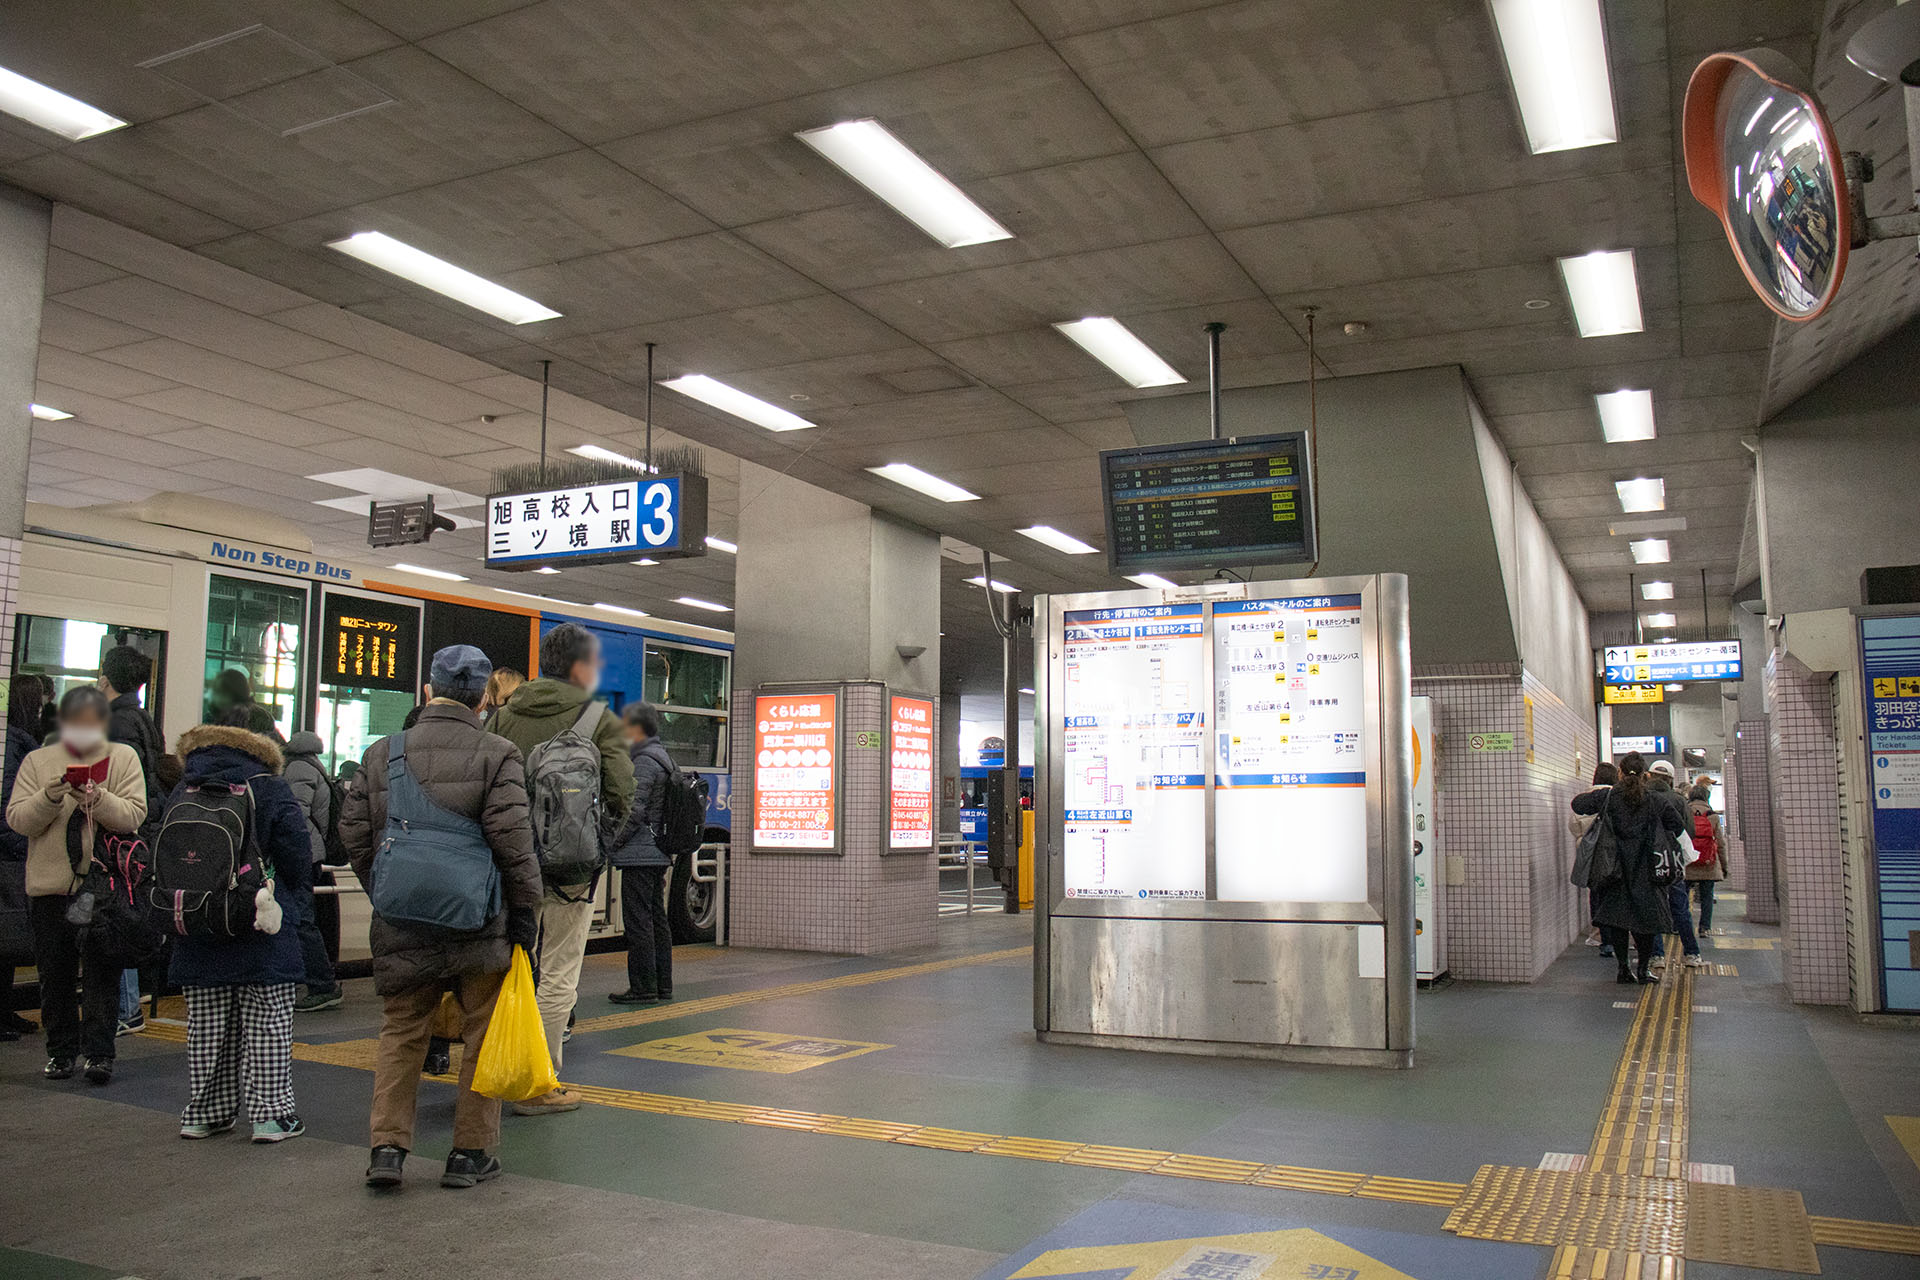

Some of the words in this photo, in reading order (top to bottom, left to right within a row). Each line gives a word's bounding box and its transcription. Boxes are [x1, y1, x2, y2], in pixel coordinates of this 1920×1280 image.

[494, 489, 630, 525] 旭高校入口
[642, 483, 674, 546] 3
[493, 519, 631, 554] 三ツ境駅
[211, 541, 256, 563] Non
[261, 551, 310, 574] Step
[314, 561, 352, 581] Bus
[357, 618, 398, 632] ニュータウン
[1277, 620, 1284, 629] 2
[1623, 650, 1629, 662] 1
[1278, 662, 1285, 671] 3
[1621, 666, 1633, 681] 0
[1691, 663, 1739, 674] 羽田空港
[1874, 701, 1920, 715] 羽田空
[1656, 737, 1665, 753] 1
[1153, 775, 1187, 785] お知らせ
[1272, 774, 1308, 784] お知らせ
